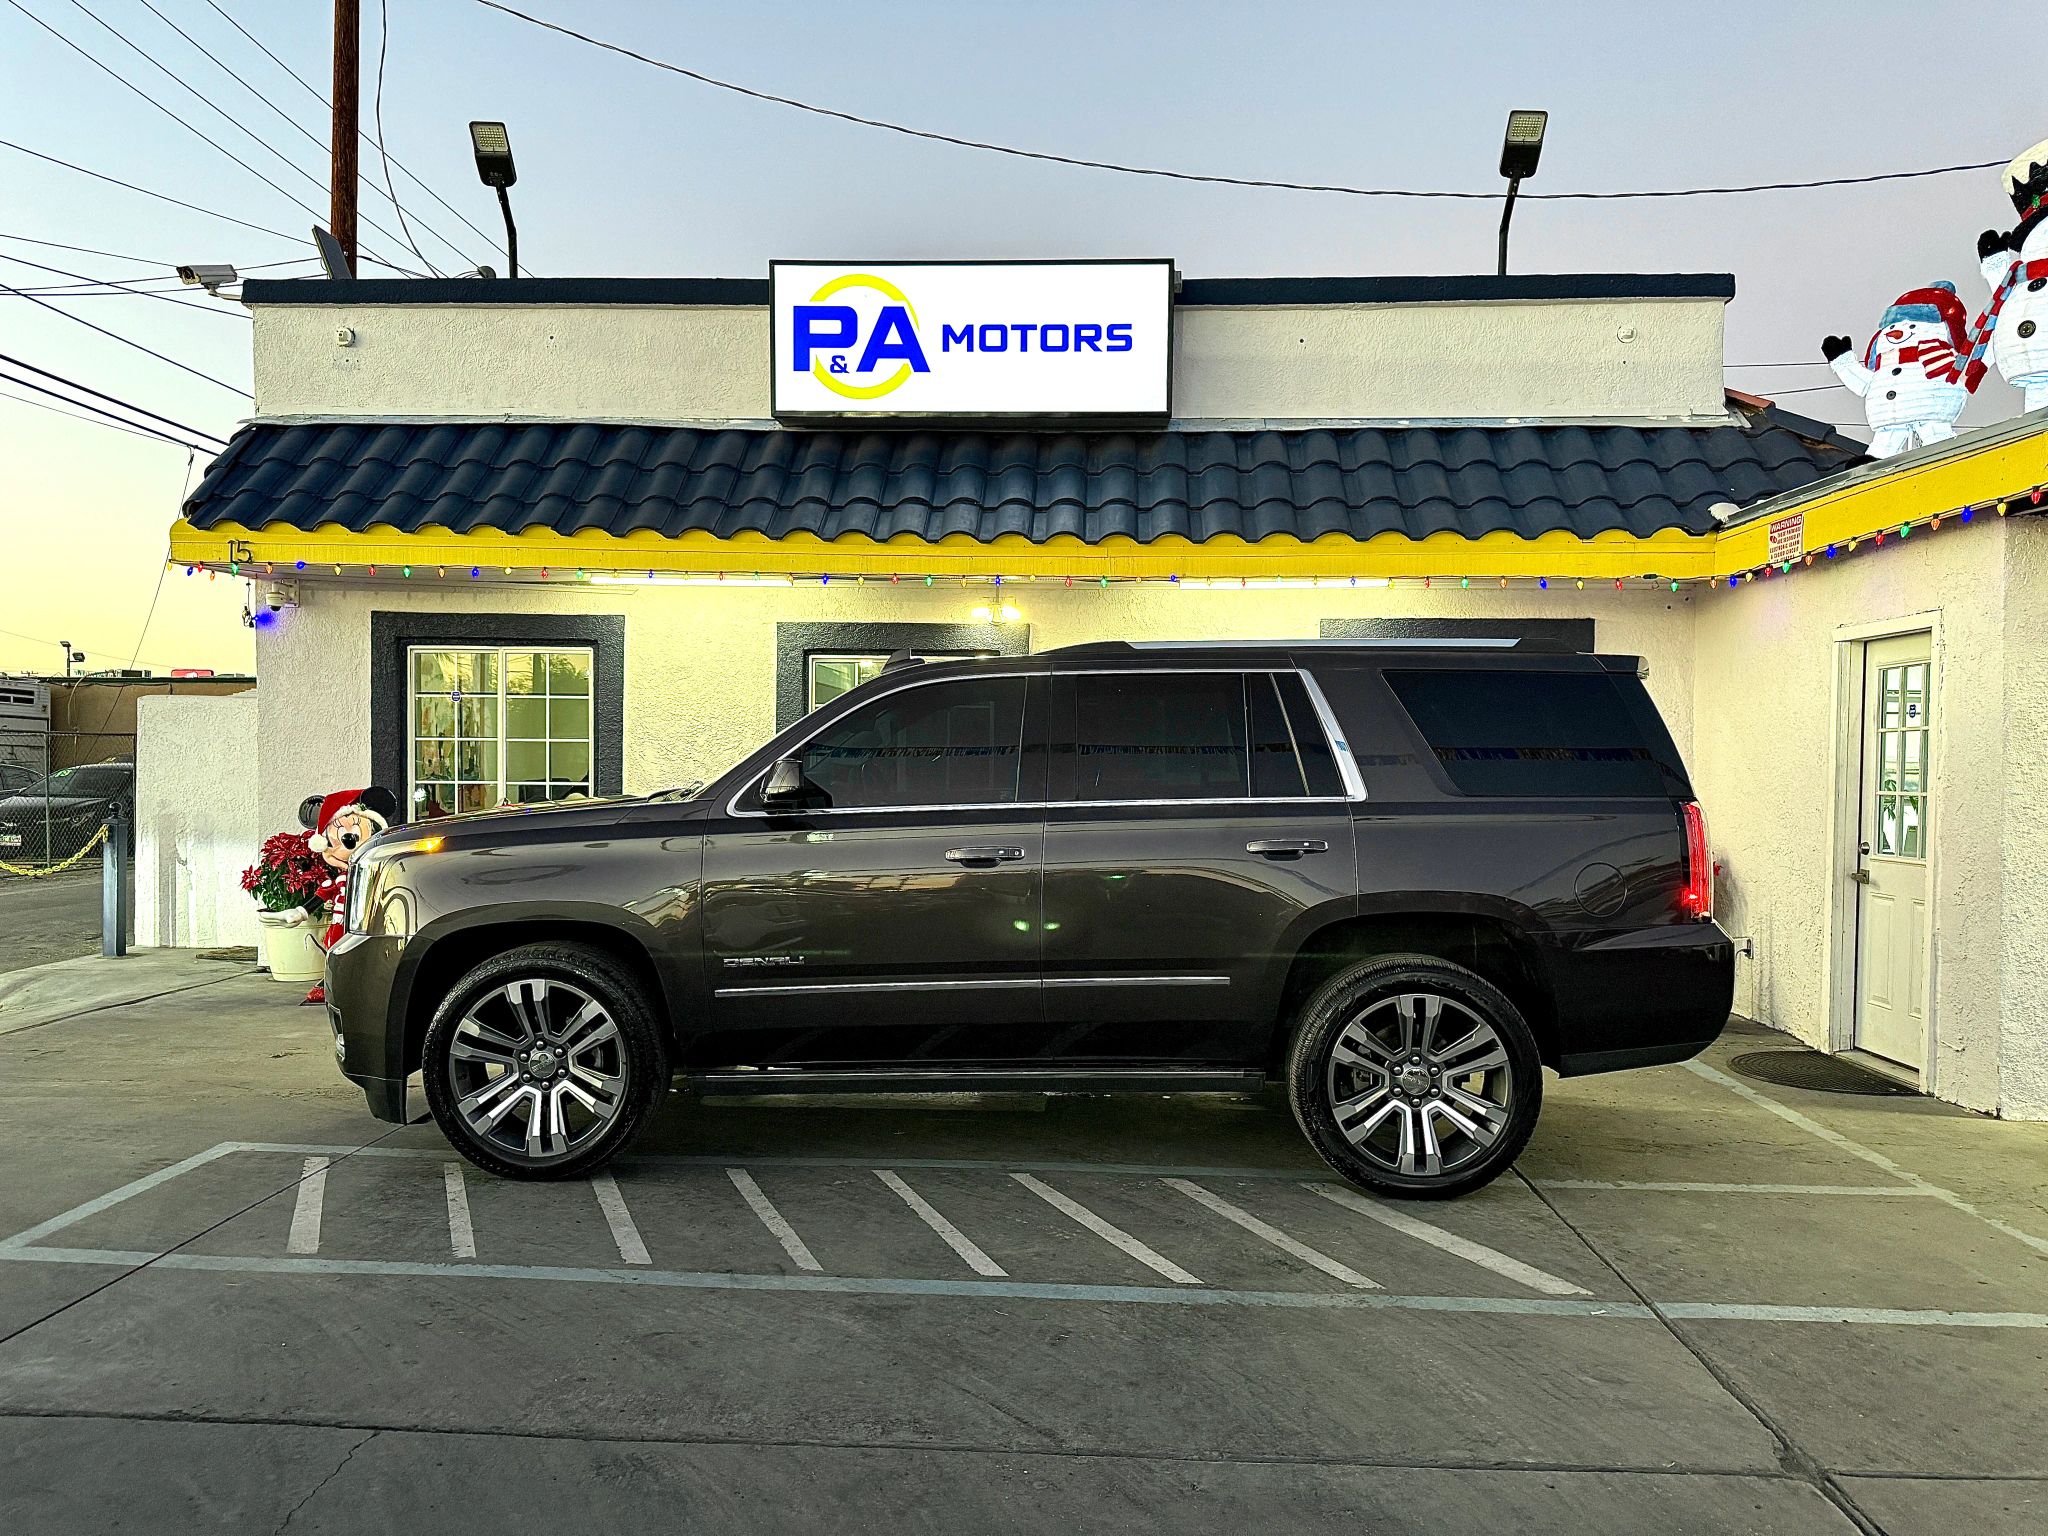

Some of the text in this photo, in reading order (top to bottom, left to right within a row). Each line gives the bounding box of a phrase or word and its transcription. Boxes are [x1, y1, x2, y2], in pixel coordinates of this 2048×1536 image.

[942, 323, 1133, 352] MOTORS
[1771, 516, 1802, 532] WARNING
[227, 539, 253, 564] 15
